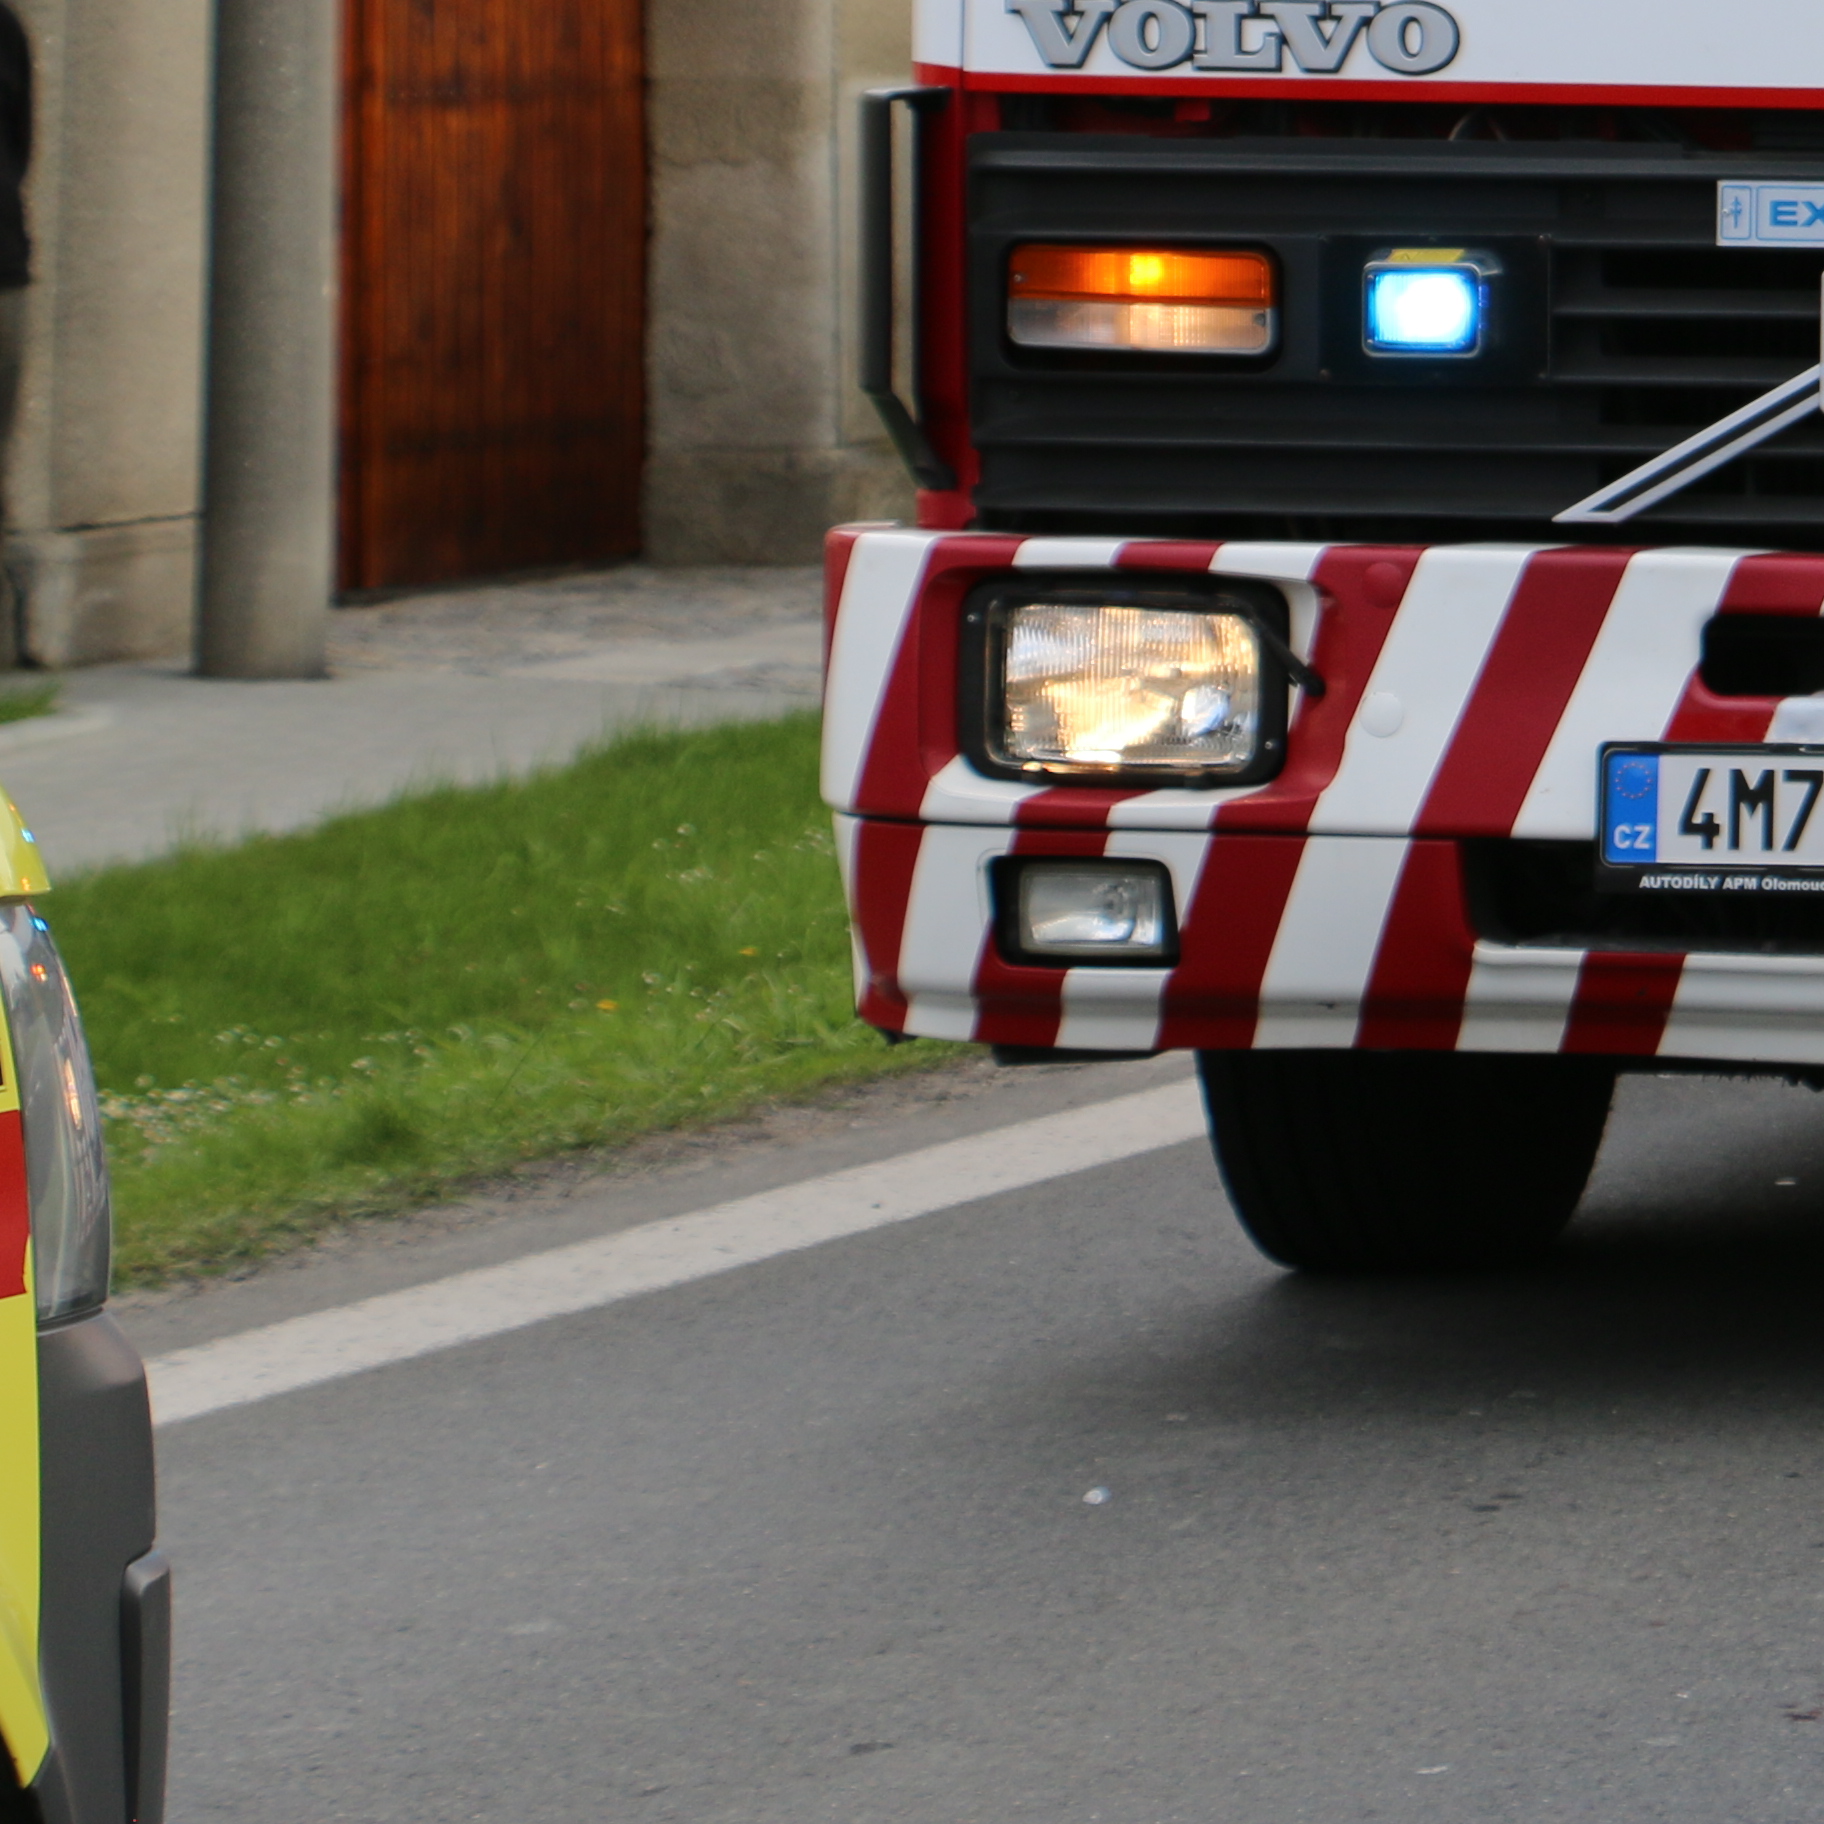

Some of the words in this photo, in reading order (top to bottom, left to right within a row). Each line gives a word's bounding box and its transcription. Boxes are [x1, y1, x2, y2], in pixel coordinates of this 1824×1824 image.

[1677, 768, 1824, 851] 4M7
[1613, 825, 1651, 850] CZ
[1639, 874, 1719, 889] AUTODÍLY
[1722, 877, 1757, 890] APM
